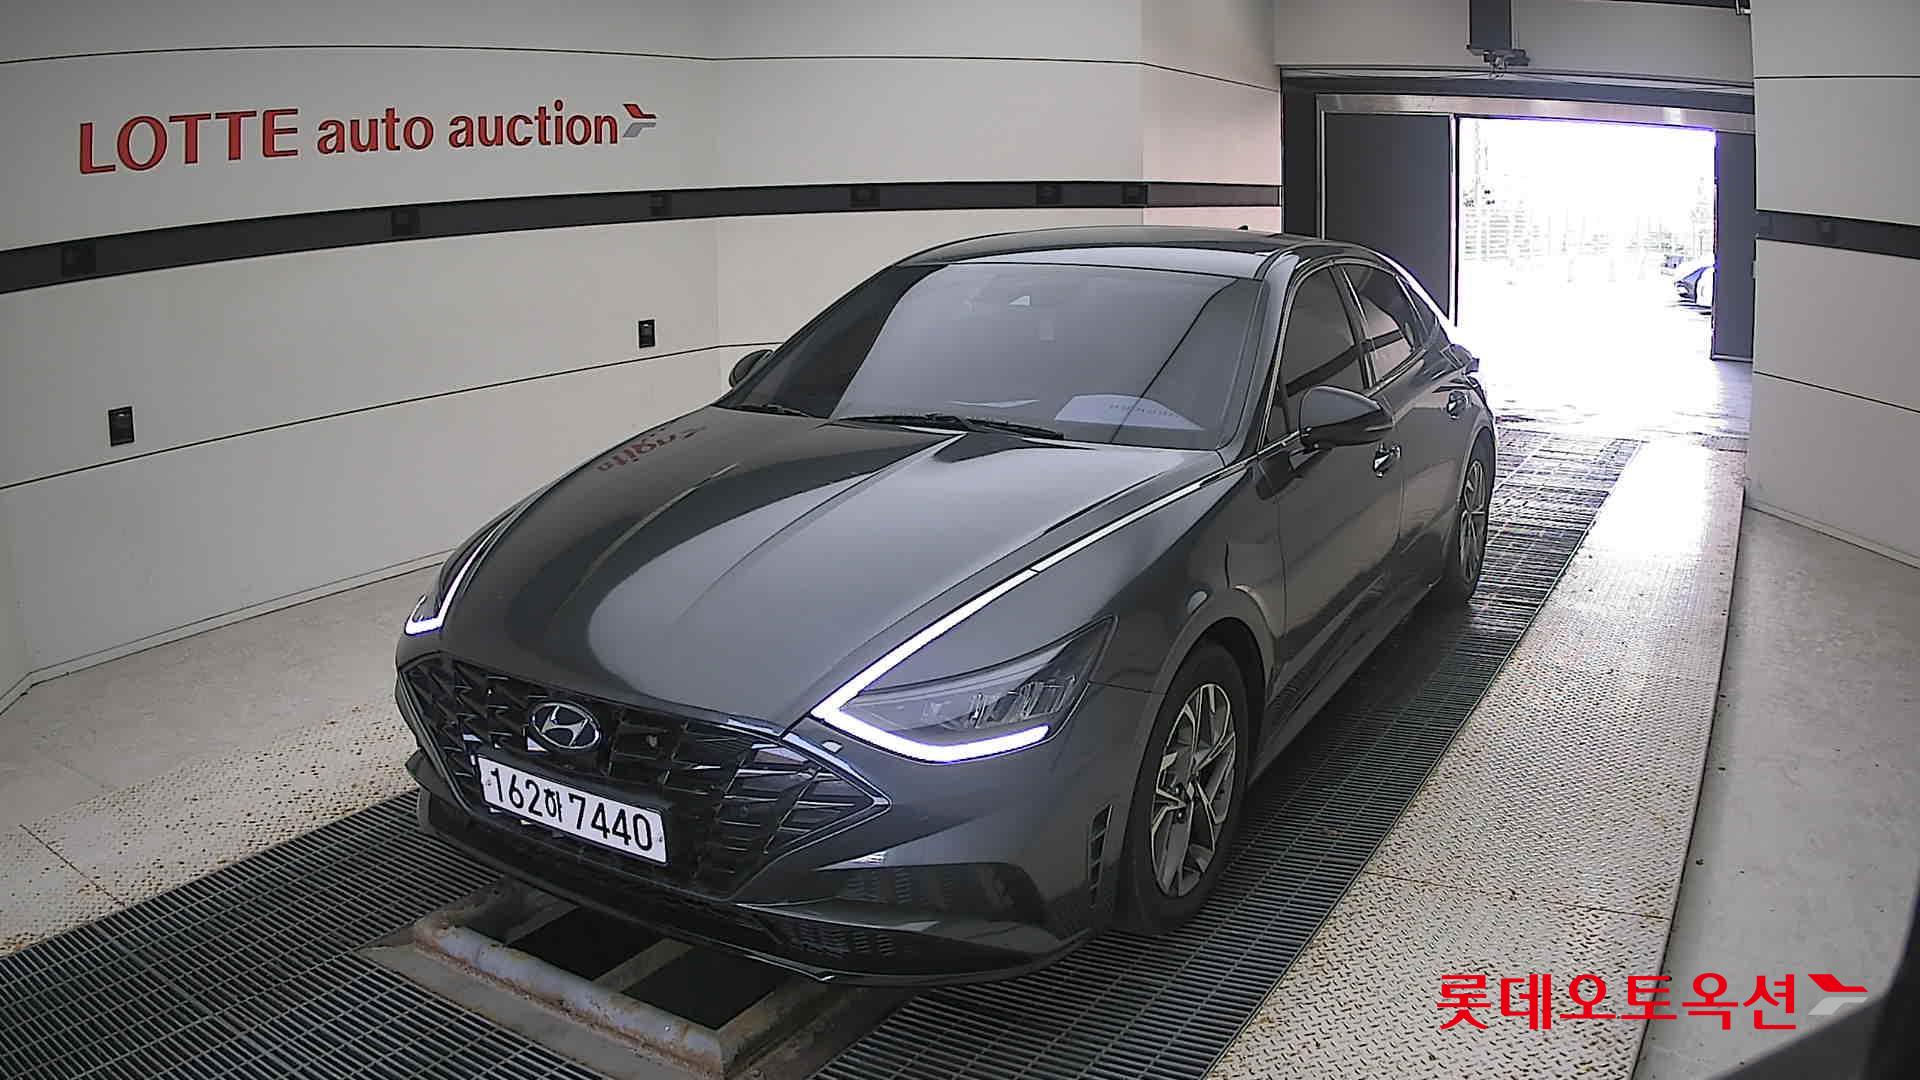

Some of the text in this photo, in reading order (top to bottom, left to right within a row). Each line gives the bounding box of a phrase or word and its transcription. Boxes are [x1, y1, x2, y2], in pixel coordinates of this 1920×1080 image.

[79, 99, 618, 175] LOTTE auto auction
[490, 767, 653, 851] 162하 7440
